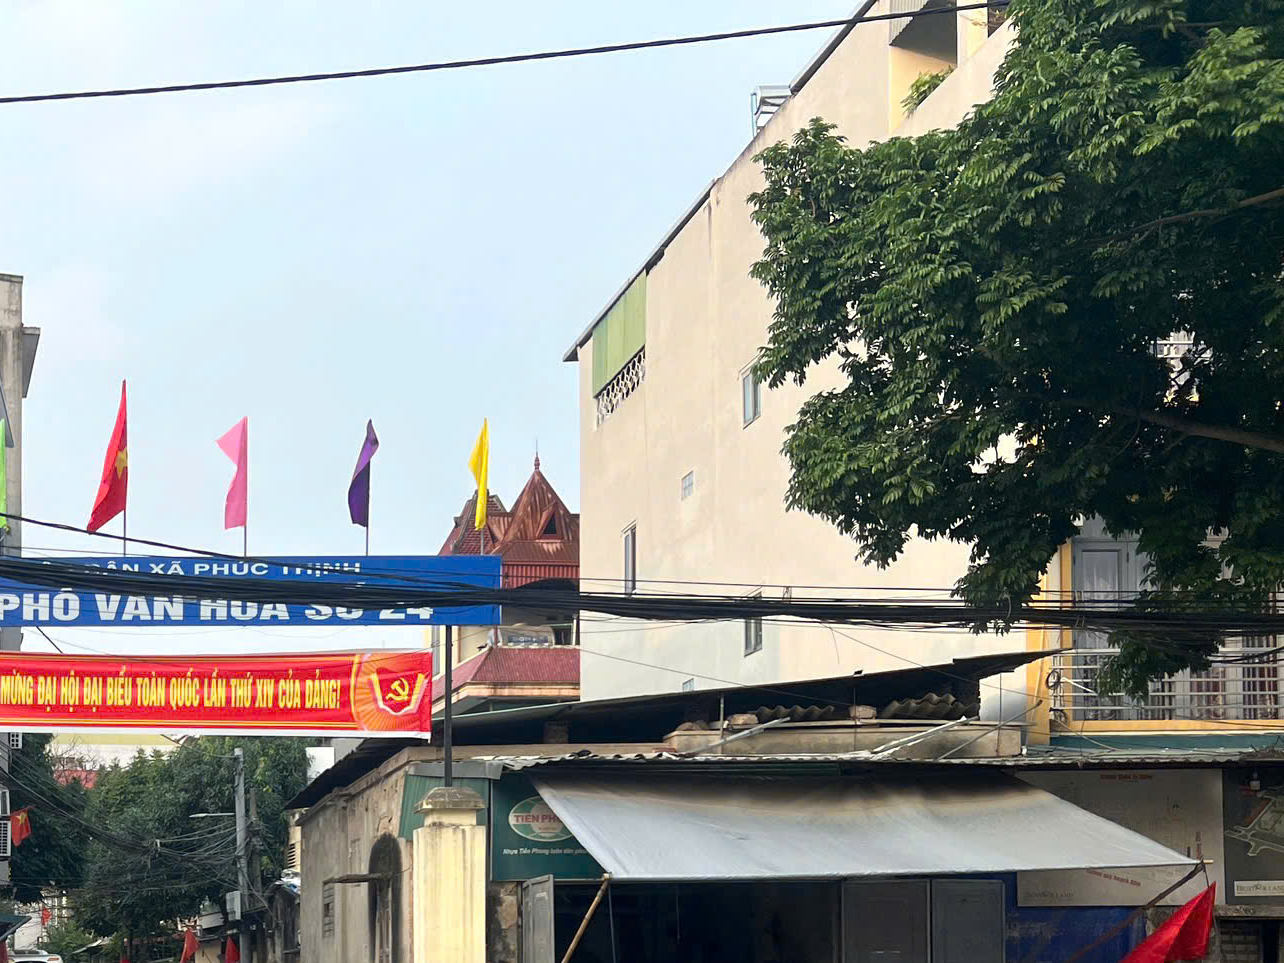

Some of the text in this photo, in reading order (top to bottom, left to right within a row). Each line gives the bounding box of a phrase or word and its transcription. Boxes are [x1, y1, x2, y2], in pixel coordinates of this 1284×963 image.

[149, 560, 185, 576] XÃ
[194, 560, 269, 576] PHÚC
[0, 668, 35, 706] MỪNG
[37, 675, 57, 712] ĐẠI
[60, 670, 80, 712] HỘI
[83, 676, 103, 712] ĐẠI
[106, 664, 133, 706] BIỂU
[136, 671, 166, 706] TOÀN
[170, 667, 200, 710] QUỐC
[230, 671, 254, 708] THỨ
[256, 678, 276, 708] XIV
[278, 668, 302, 709] CỦA
[305, 669, 341, 709] ĐẢNG!
